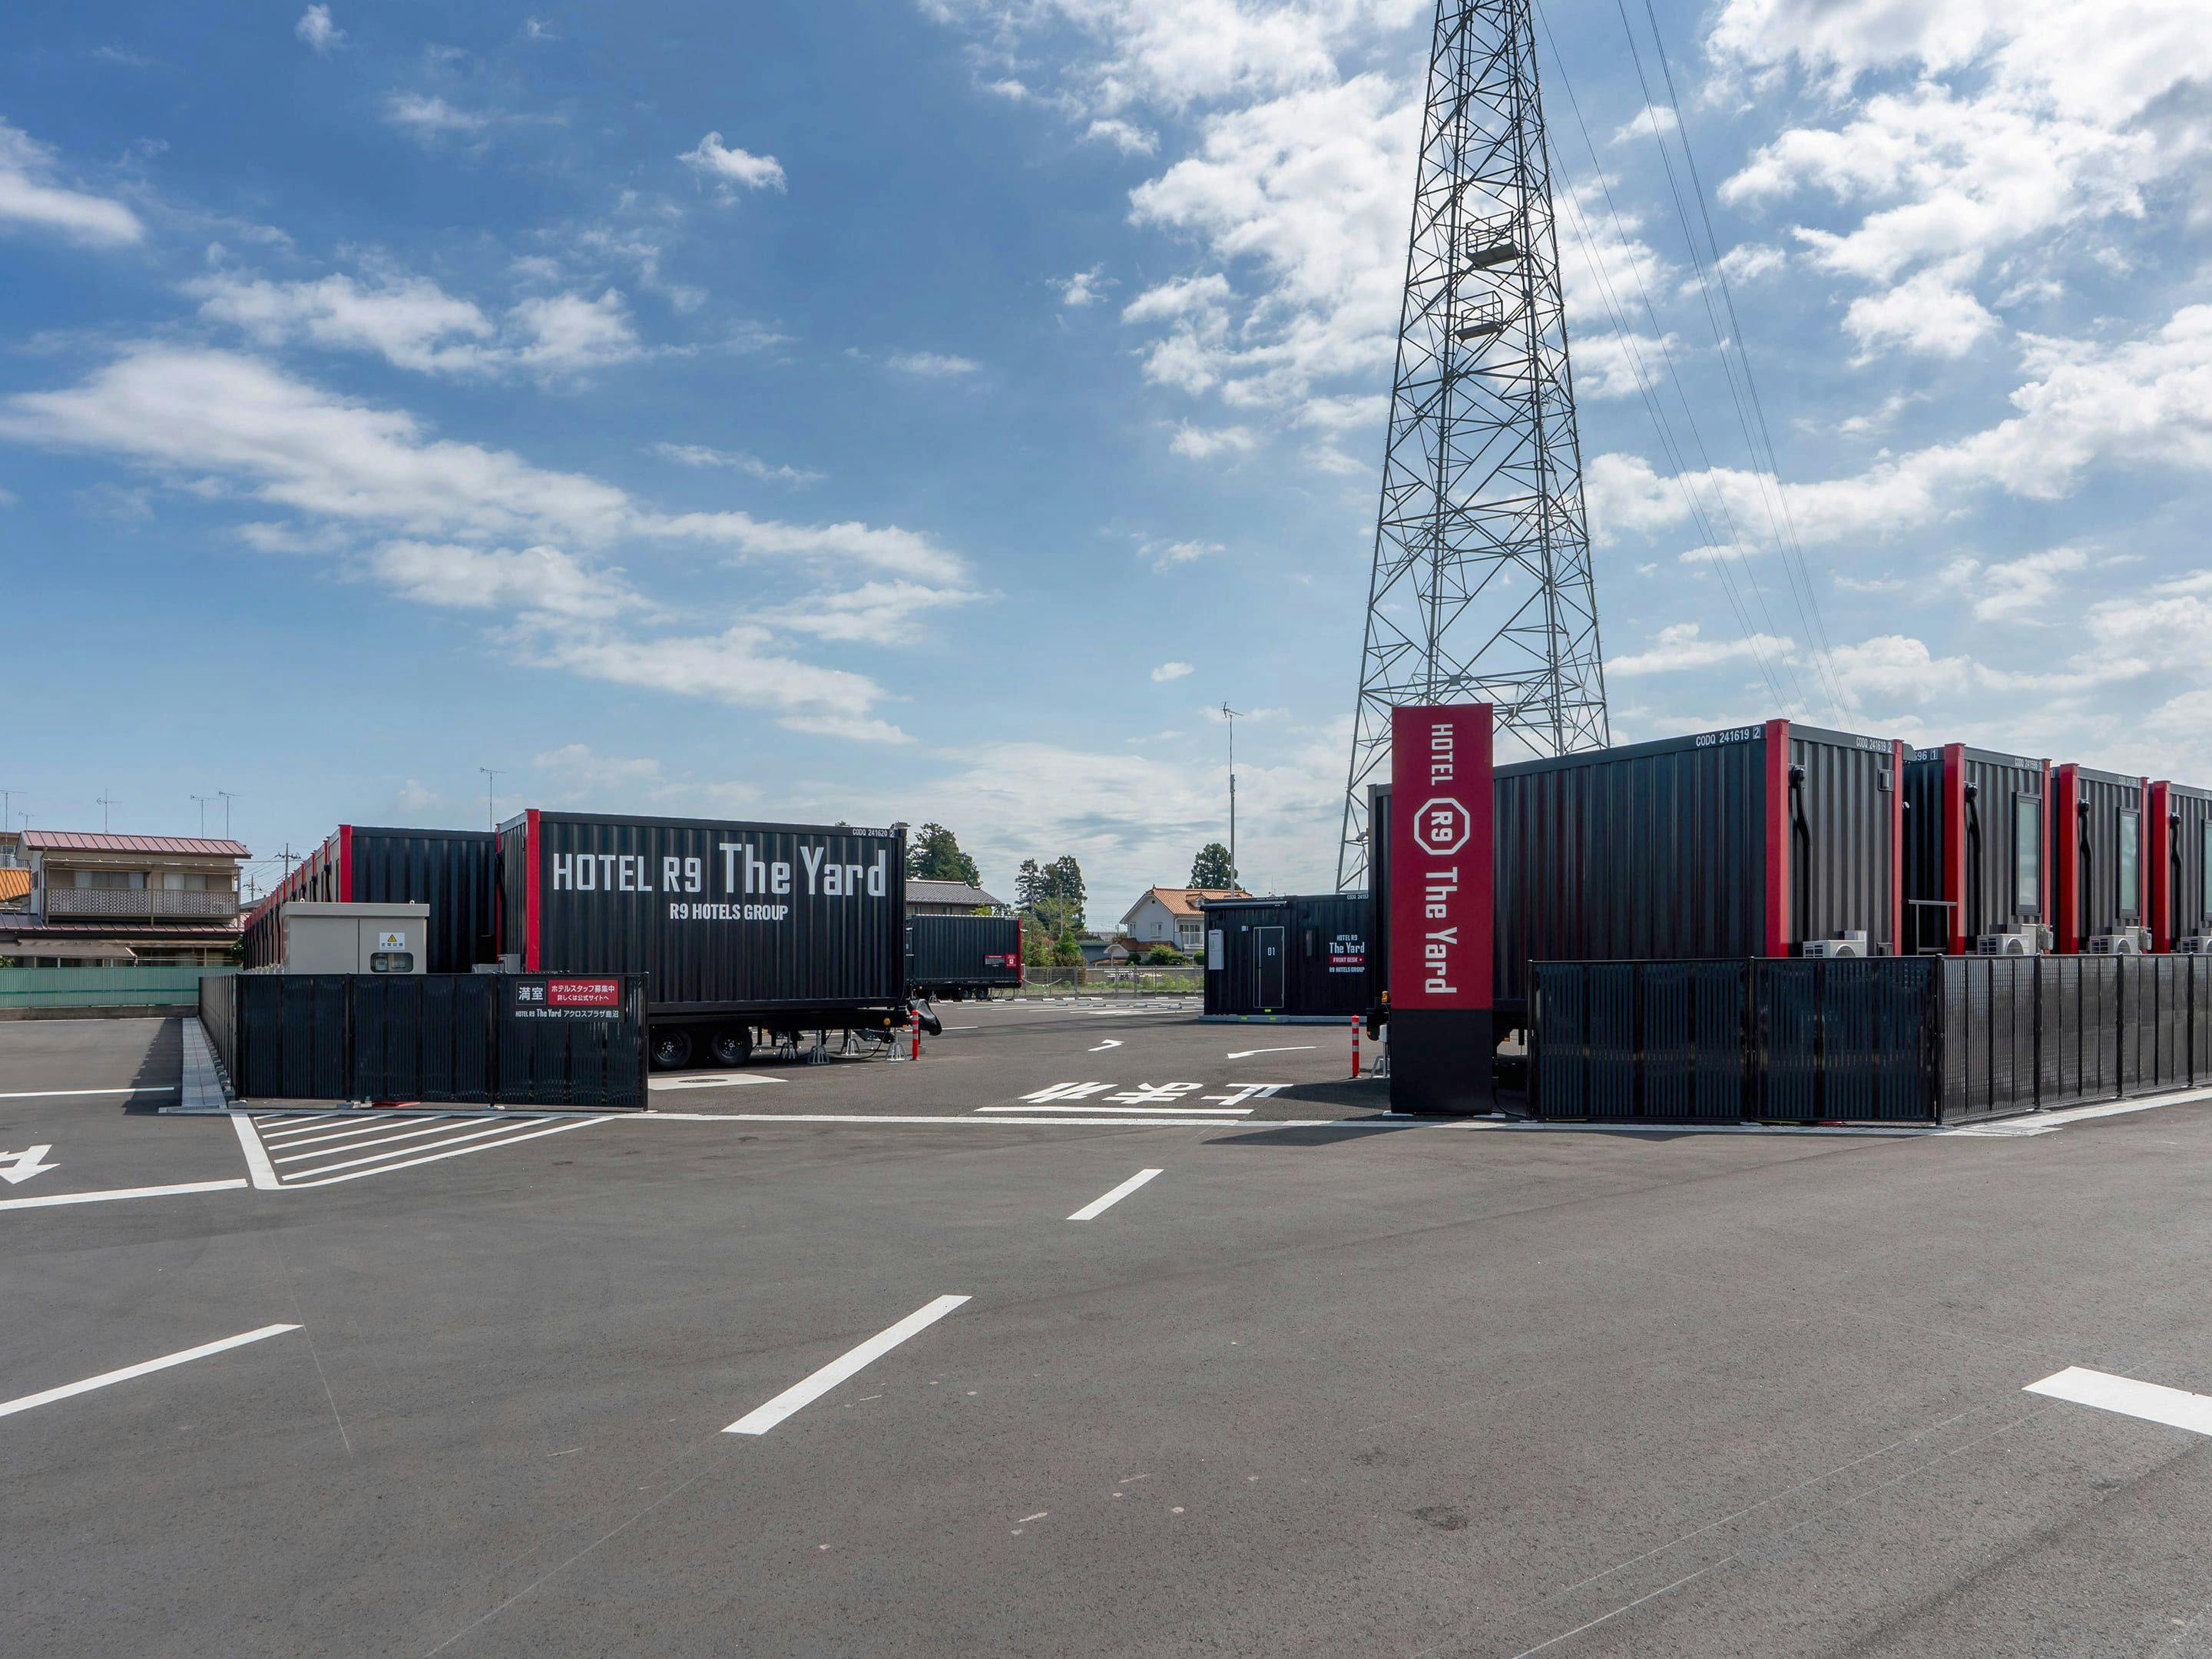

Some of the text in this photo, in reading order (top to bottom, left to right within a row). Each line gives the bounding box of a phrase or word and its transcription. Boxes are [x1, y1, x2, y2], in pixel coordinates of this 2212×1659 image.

[1696, 734, 1716, 747] CODQ
[1719, 729, 1750, 743] 241619
[1869, 740, 1886, 751] 241619
[1426, 724, 1458, 993] HOTEL R9 The Yard
[553, 843, 886, 896] HOTEL R9 The Yard
[670, 903, 788, 921] R9 HOTELS GROUP
[1267, 947, 1275, 955] 01
[1329, 942, 1365, 953] The Yard
[518, 987, 544, 1001] 満室
[551, 985, 615, 993] ホテルスタッフ募集中
[536, 1008, 548, 1018] The
[548, 1008, 561, 1018] Yard
